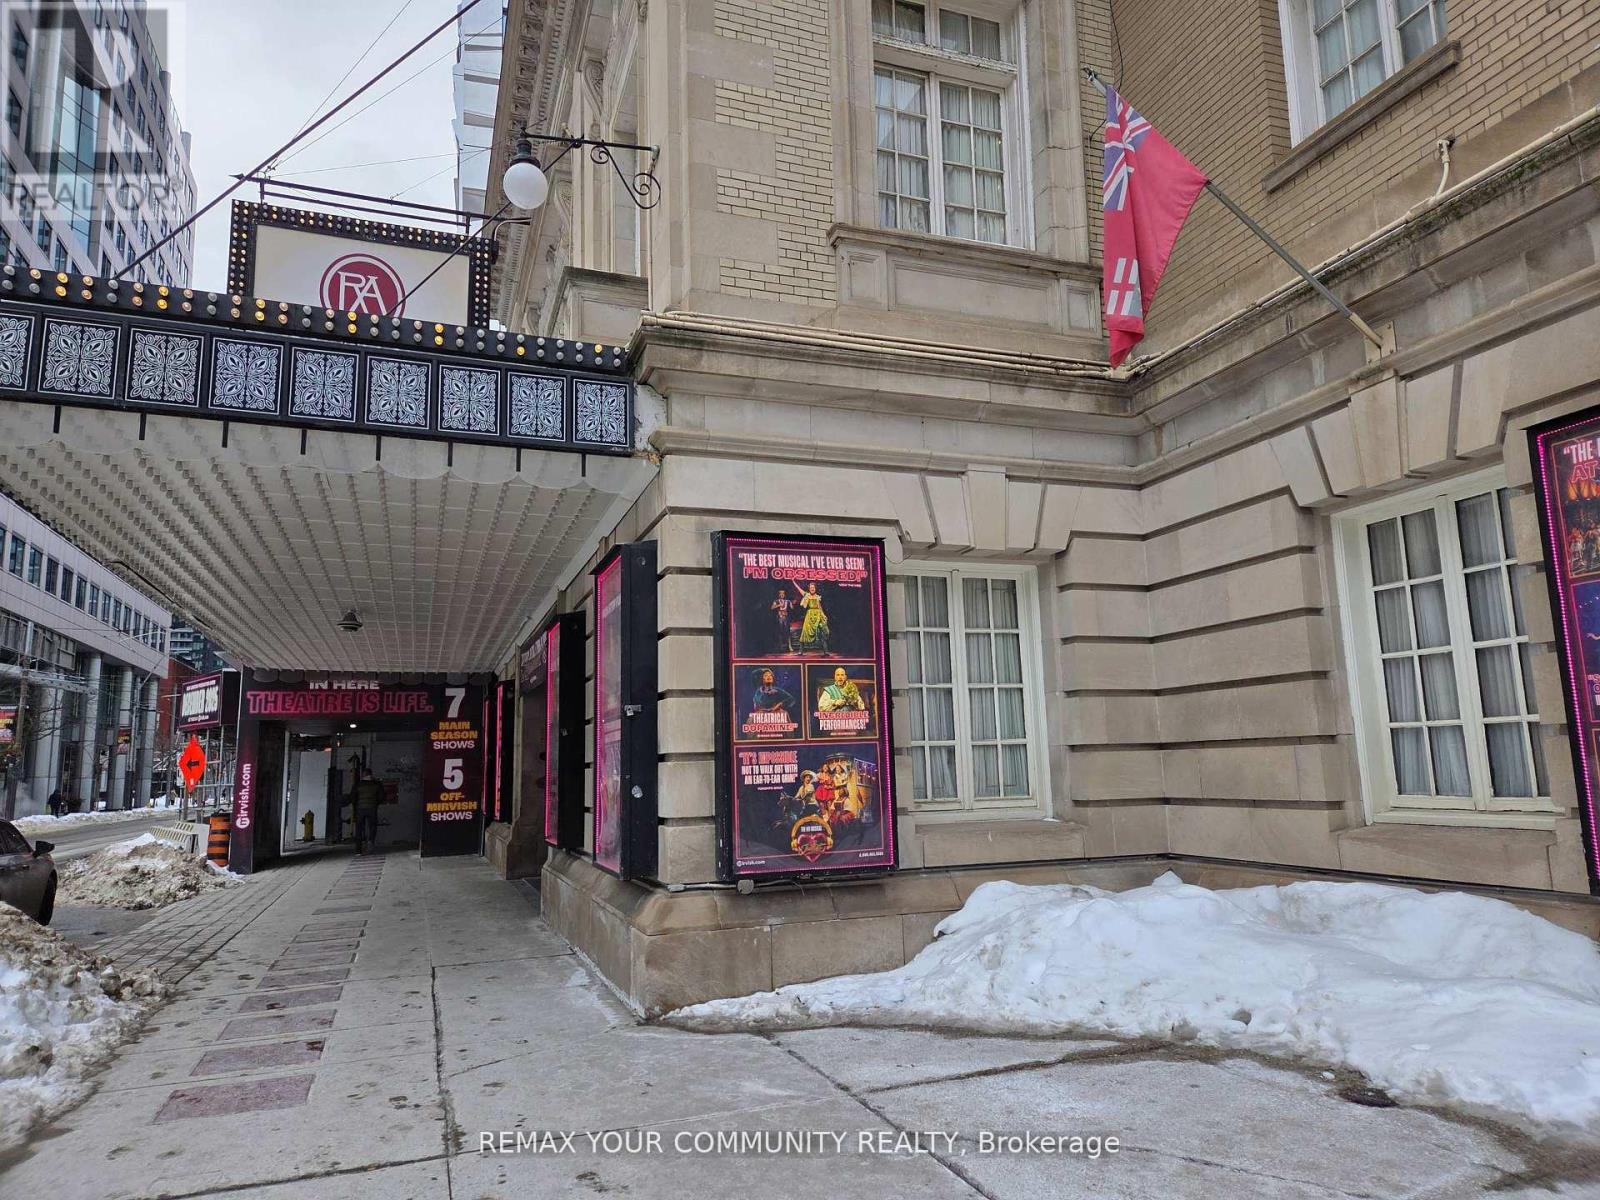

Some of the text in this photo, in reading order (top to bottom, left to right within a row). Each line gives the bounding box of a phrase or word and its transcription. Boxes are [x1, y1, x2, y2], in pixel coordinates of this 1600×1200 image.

[1563, 440, 1594, 464] "THE
[739, 553, 757, 567] "THE
[759, 554, 776, 568] BEST
[778, 555, 809, 569] MUSICAL
[811, 556, 825, 569] I'VE
[827, 556, 844, 570] EVER
[309, 680, 380, 690] IN HERE
[247, 691, 434, 713] THEATRE IS LIFE.
[445, 687, 466, 718] 7
[439, 722, 471, 730] MAIN
[430, 730, 478, 740] SEASON
[433, 740, 475, 750] SHOWS
[443, 758, 464, 790] 5
[440, 792, 465, 801] OFF-
[426, 801, 478, 812] MIRVISH
[430, 811, 473, 822] SHOWS
